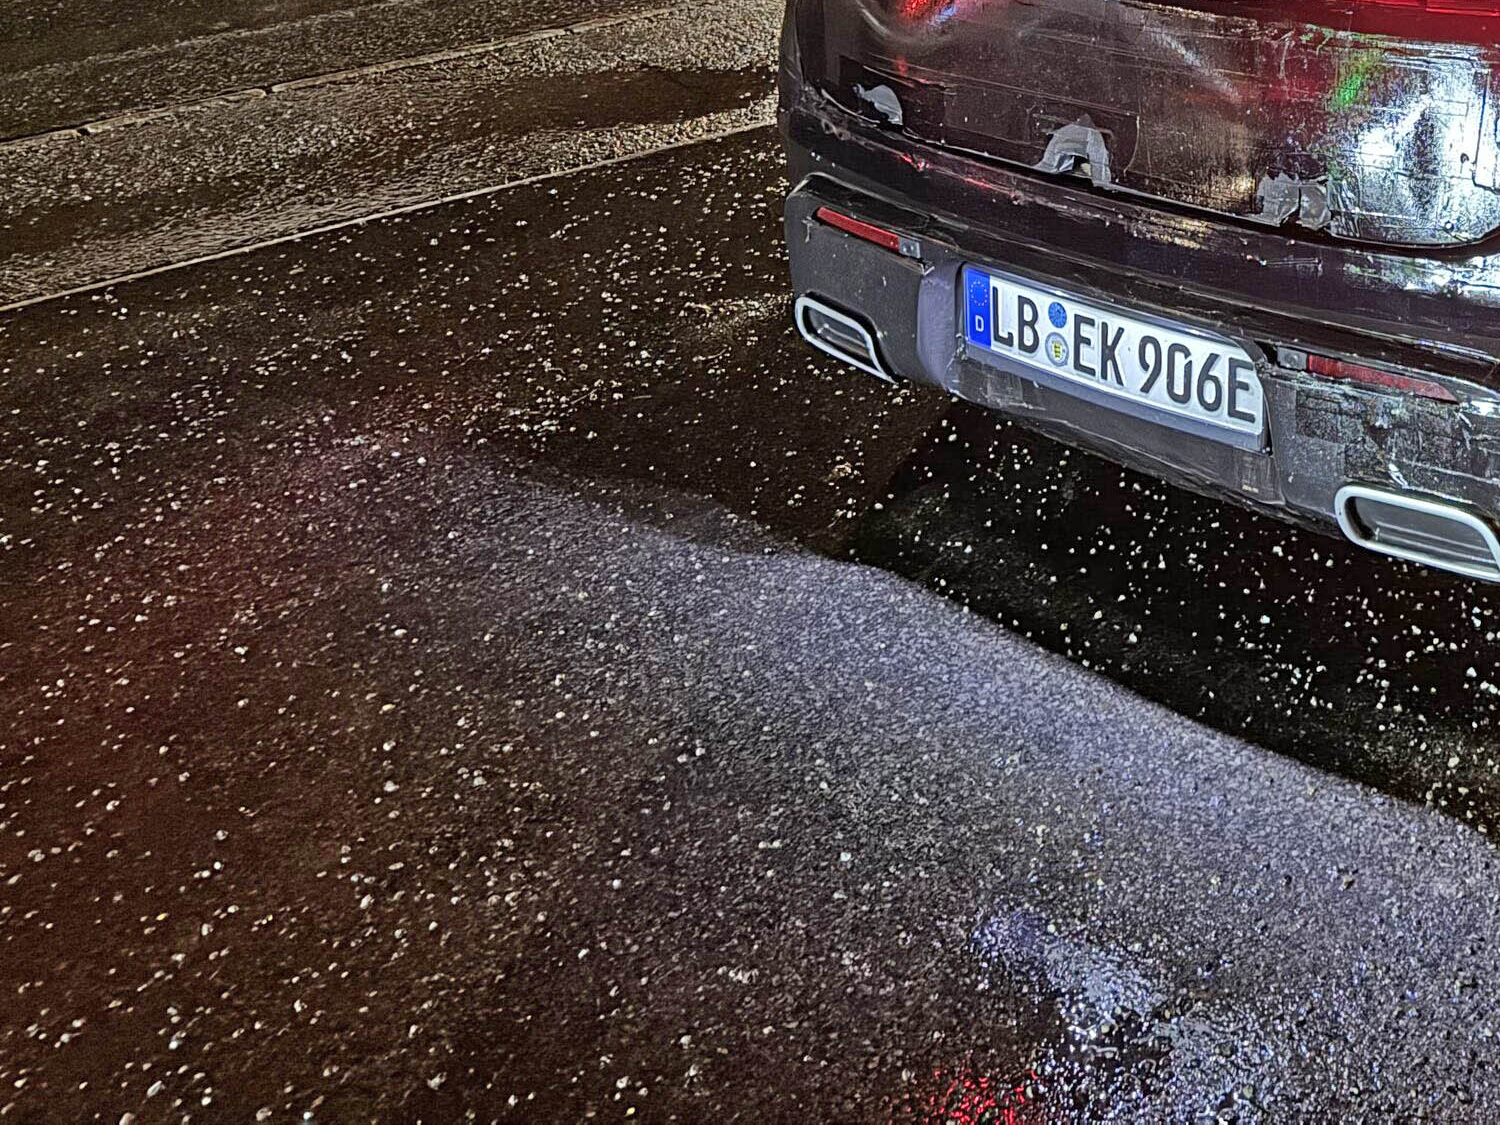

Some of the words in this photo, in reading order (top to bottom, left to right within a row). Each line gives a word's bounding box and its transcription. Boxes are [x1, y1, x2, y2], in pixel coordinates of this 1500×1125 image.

[974, 314, 985, 333] D
[991, 285, 1040, 354] LB
[1072, 312, 1125, 387] EK
[1137, 334, 1257, 424] 906E
